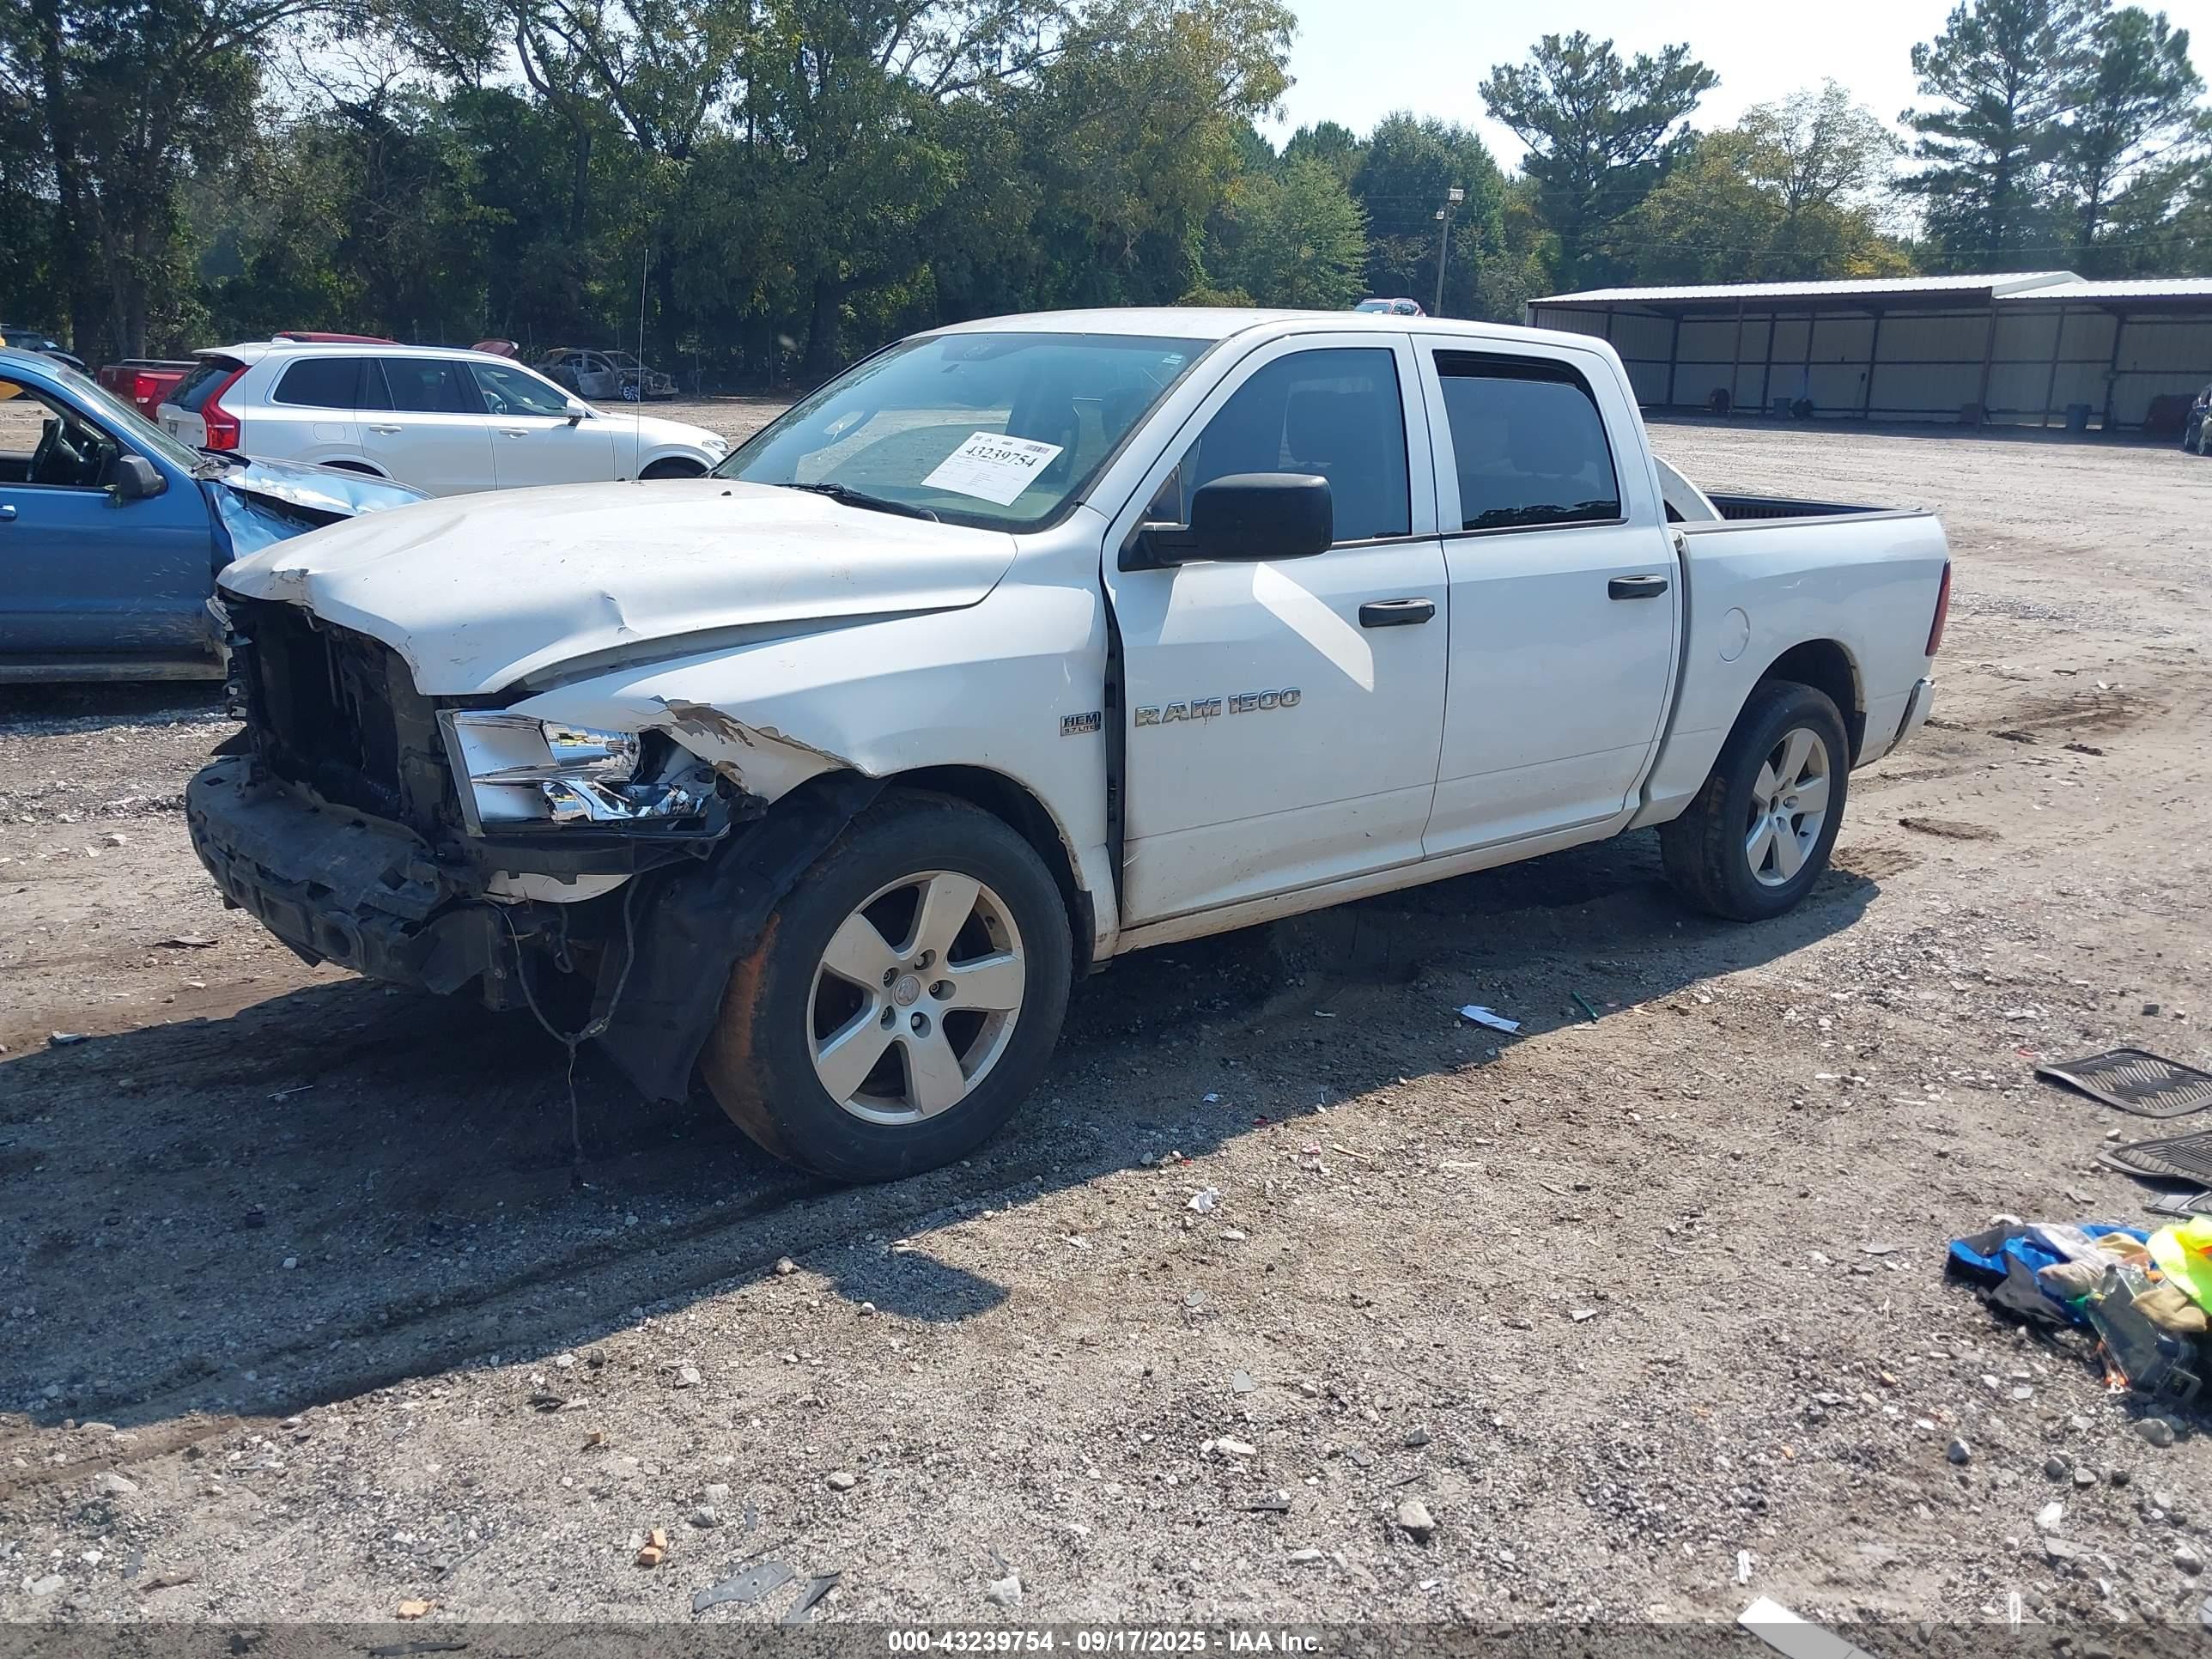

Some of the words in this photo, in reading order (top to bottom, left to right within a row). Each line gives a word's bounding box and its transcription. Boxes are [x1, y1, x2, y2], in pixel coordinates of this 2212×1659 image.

[965, 446, 1038, 468] 43239754
[1134, 697, 1223, 727] RAM
[1228, 687, 1302, 714] 1500
